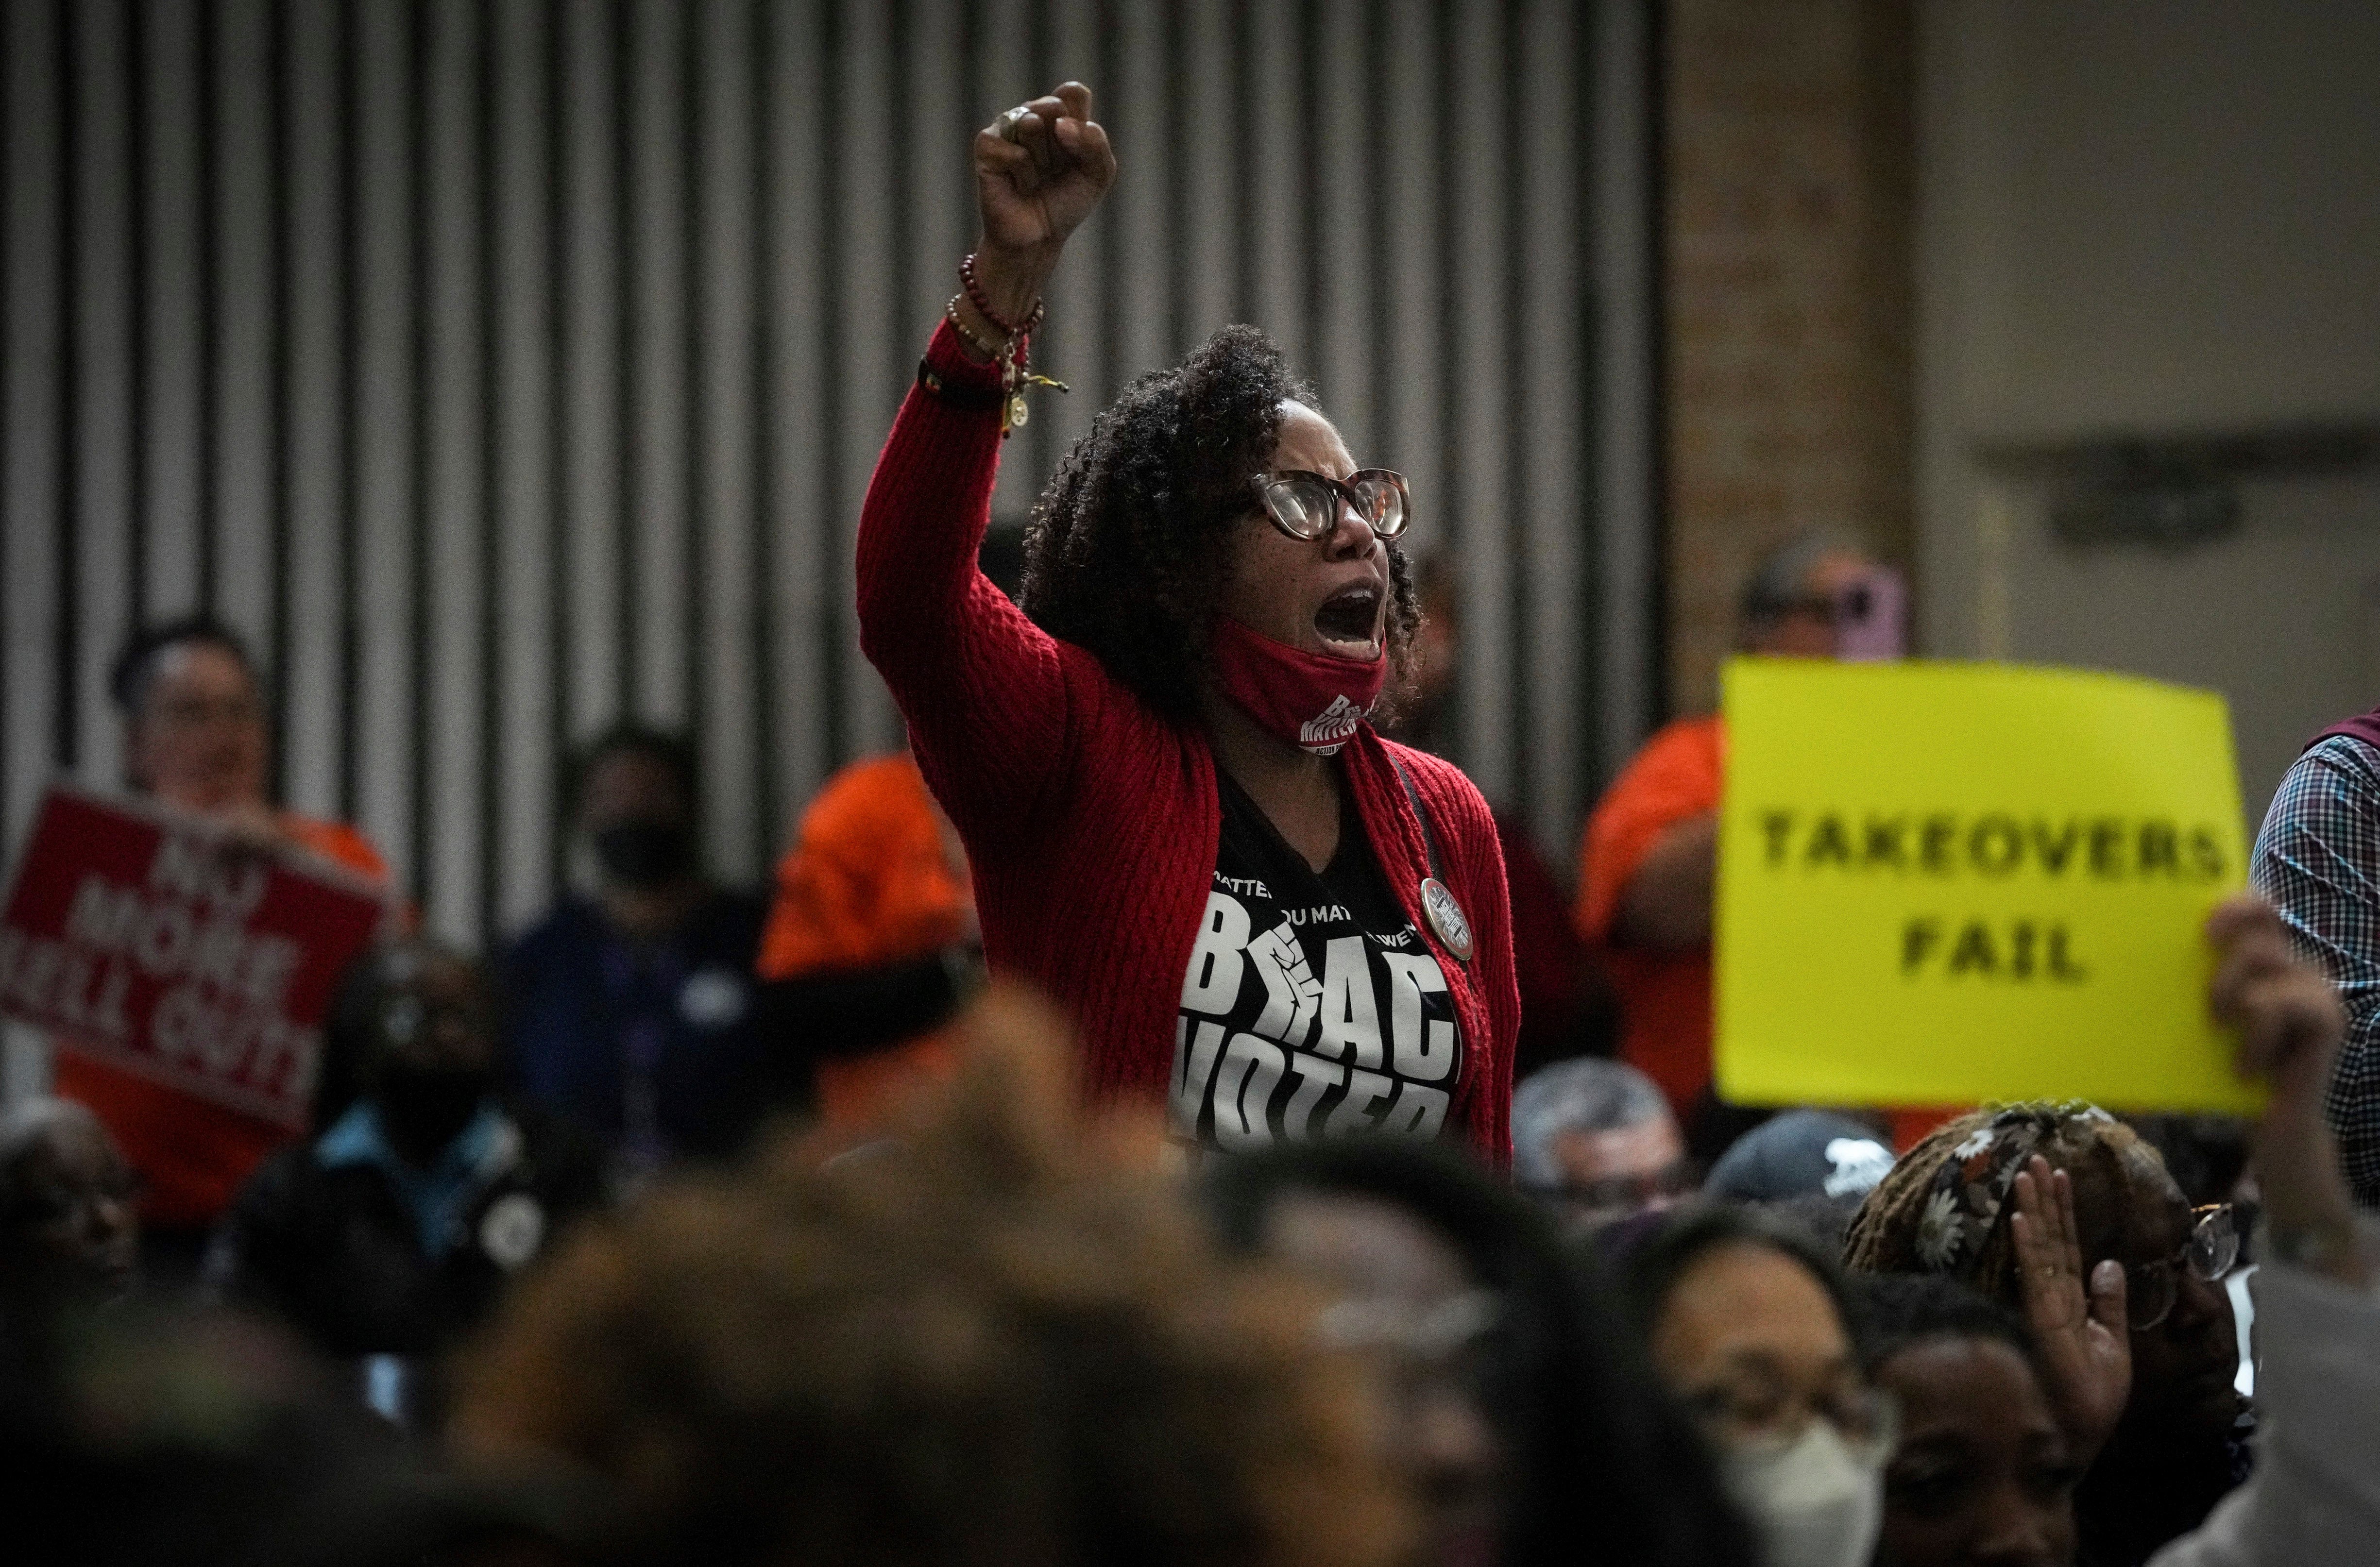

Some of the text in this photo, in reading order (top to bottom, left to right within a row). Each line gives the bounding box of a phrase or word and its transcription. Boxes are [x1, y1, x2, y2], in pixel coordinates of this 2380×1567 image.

[1757, 809, 2227, 881] TAKEOVERS
[1214, 870, 1272, 899] ATTE
[1311, 905, 1351, 924] MAT
[65, 872, 304, 1003] MORE
[1900, 915, 2089, 986] FAIL
